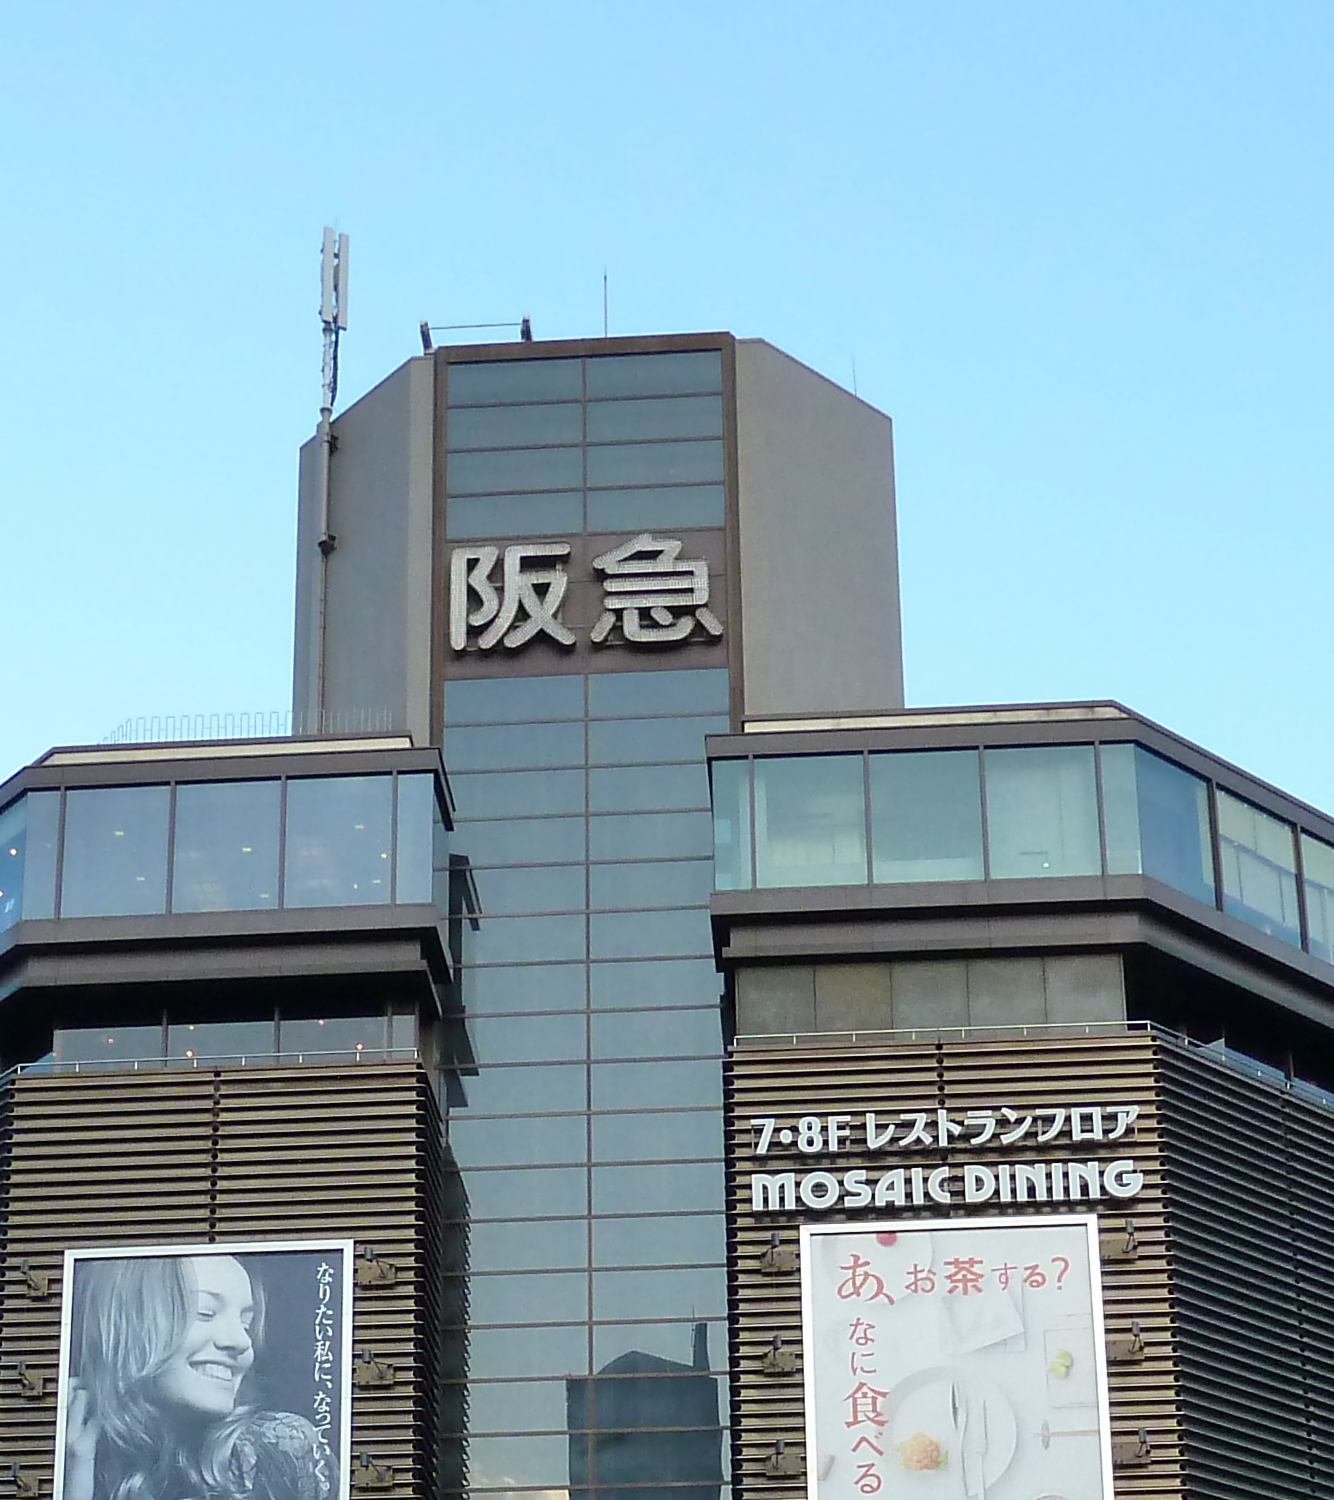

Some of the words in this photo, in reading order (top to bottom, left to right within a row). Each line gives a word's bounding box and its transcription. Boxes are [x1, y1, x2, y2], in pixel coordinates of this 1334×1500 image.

[449, 533, 724, 652] 阪急
[750, 1113, 852, 1155] 7・8F
[866, 1105, 1141, 1151] レストランフロア
[750, 1165, 952, 1211] MOSAIC
[964, 1159, 1144, 1201] DINING
